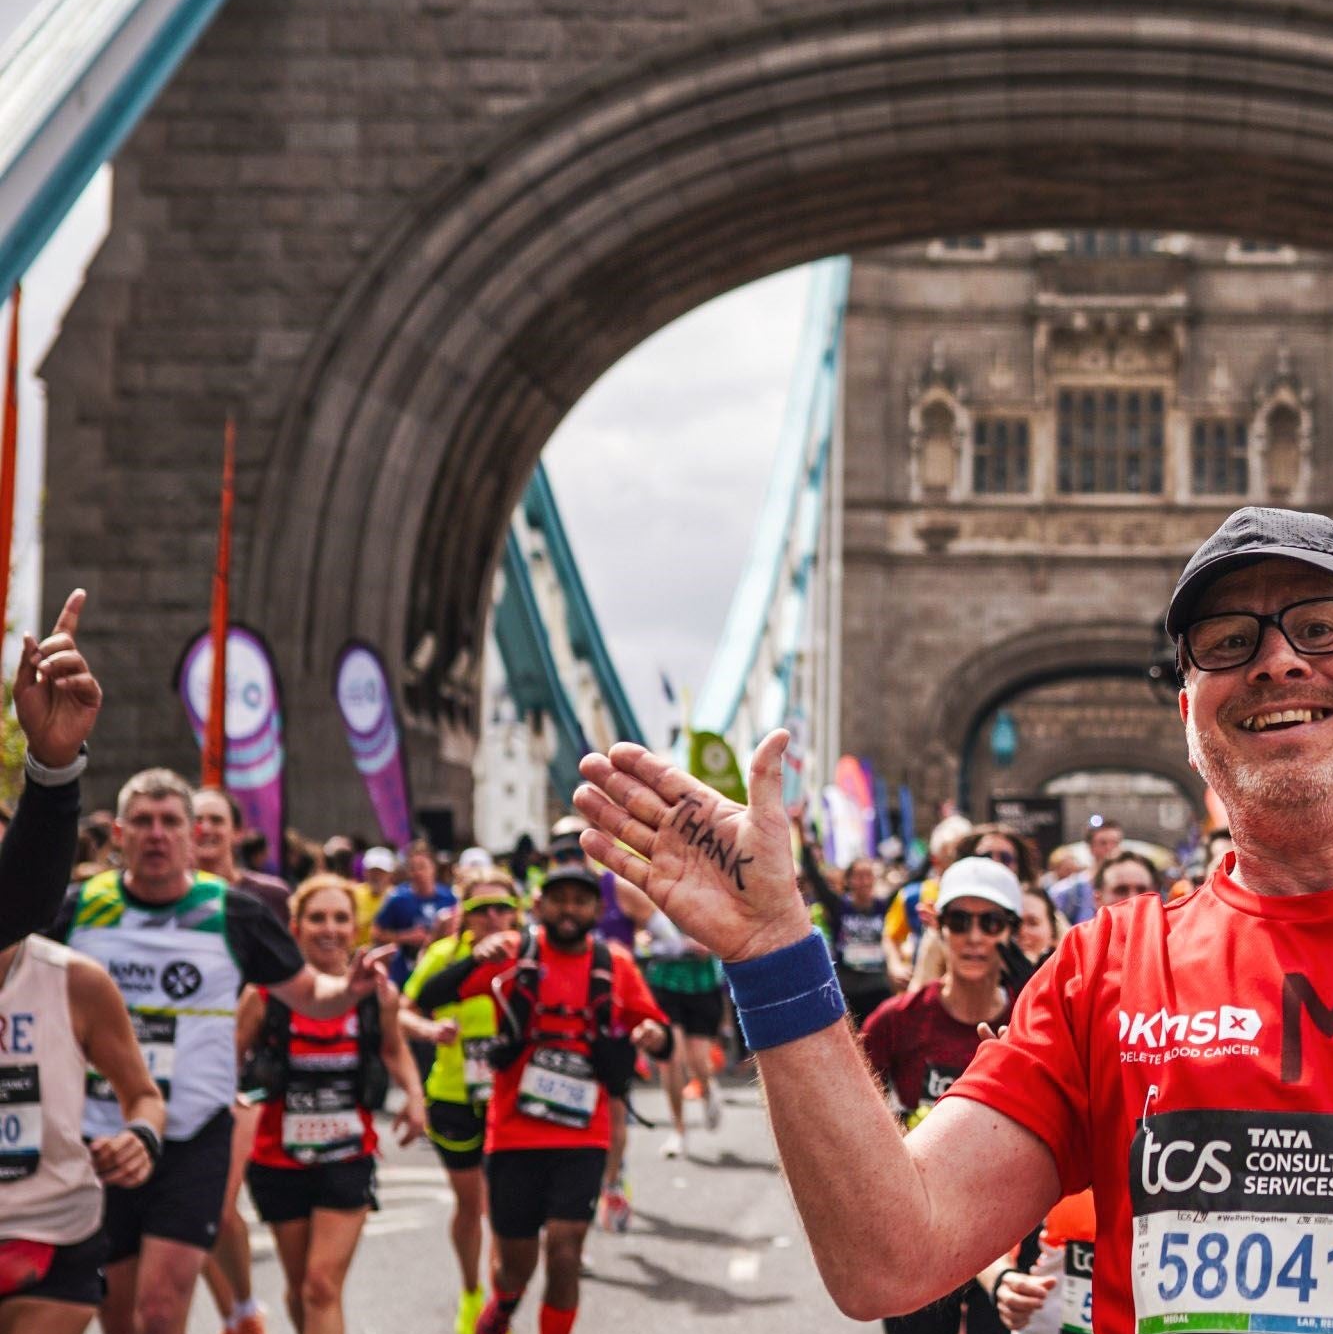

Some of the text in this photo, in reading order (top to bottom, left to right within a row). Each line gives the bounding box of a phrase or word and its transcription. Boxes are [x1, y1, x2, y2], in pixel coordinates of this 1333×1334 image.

[671, 794, 754, 891] THANK
[1120, 1044, 1259, 1065] DELETE BLOOD CANCER
[1247, 1128, 1312, 1149] TATA
[1142, 1131, 1231, 1194] tcs
[1217, 1214, 1288, 1224] #WeRunTogether
[1163, 1314, 1189, 1324] MEDAL
